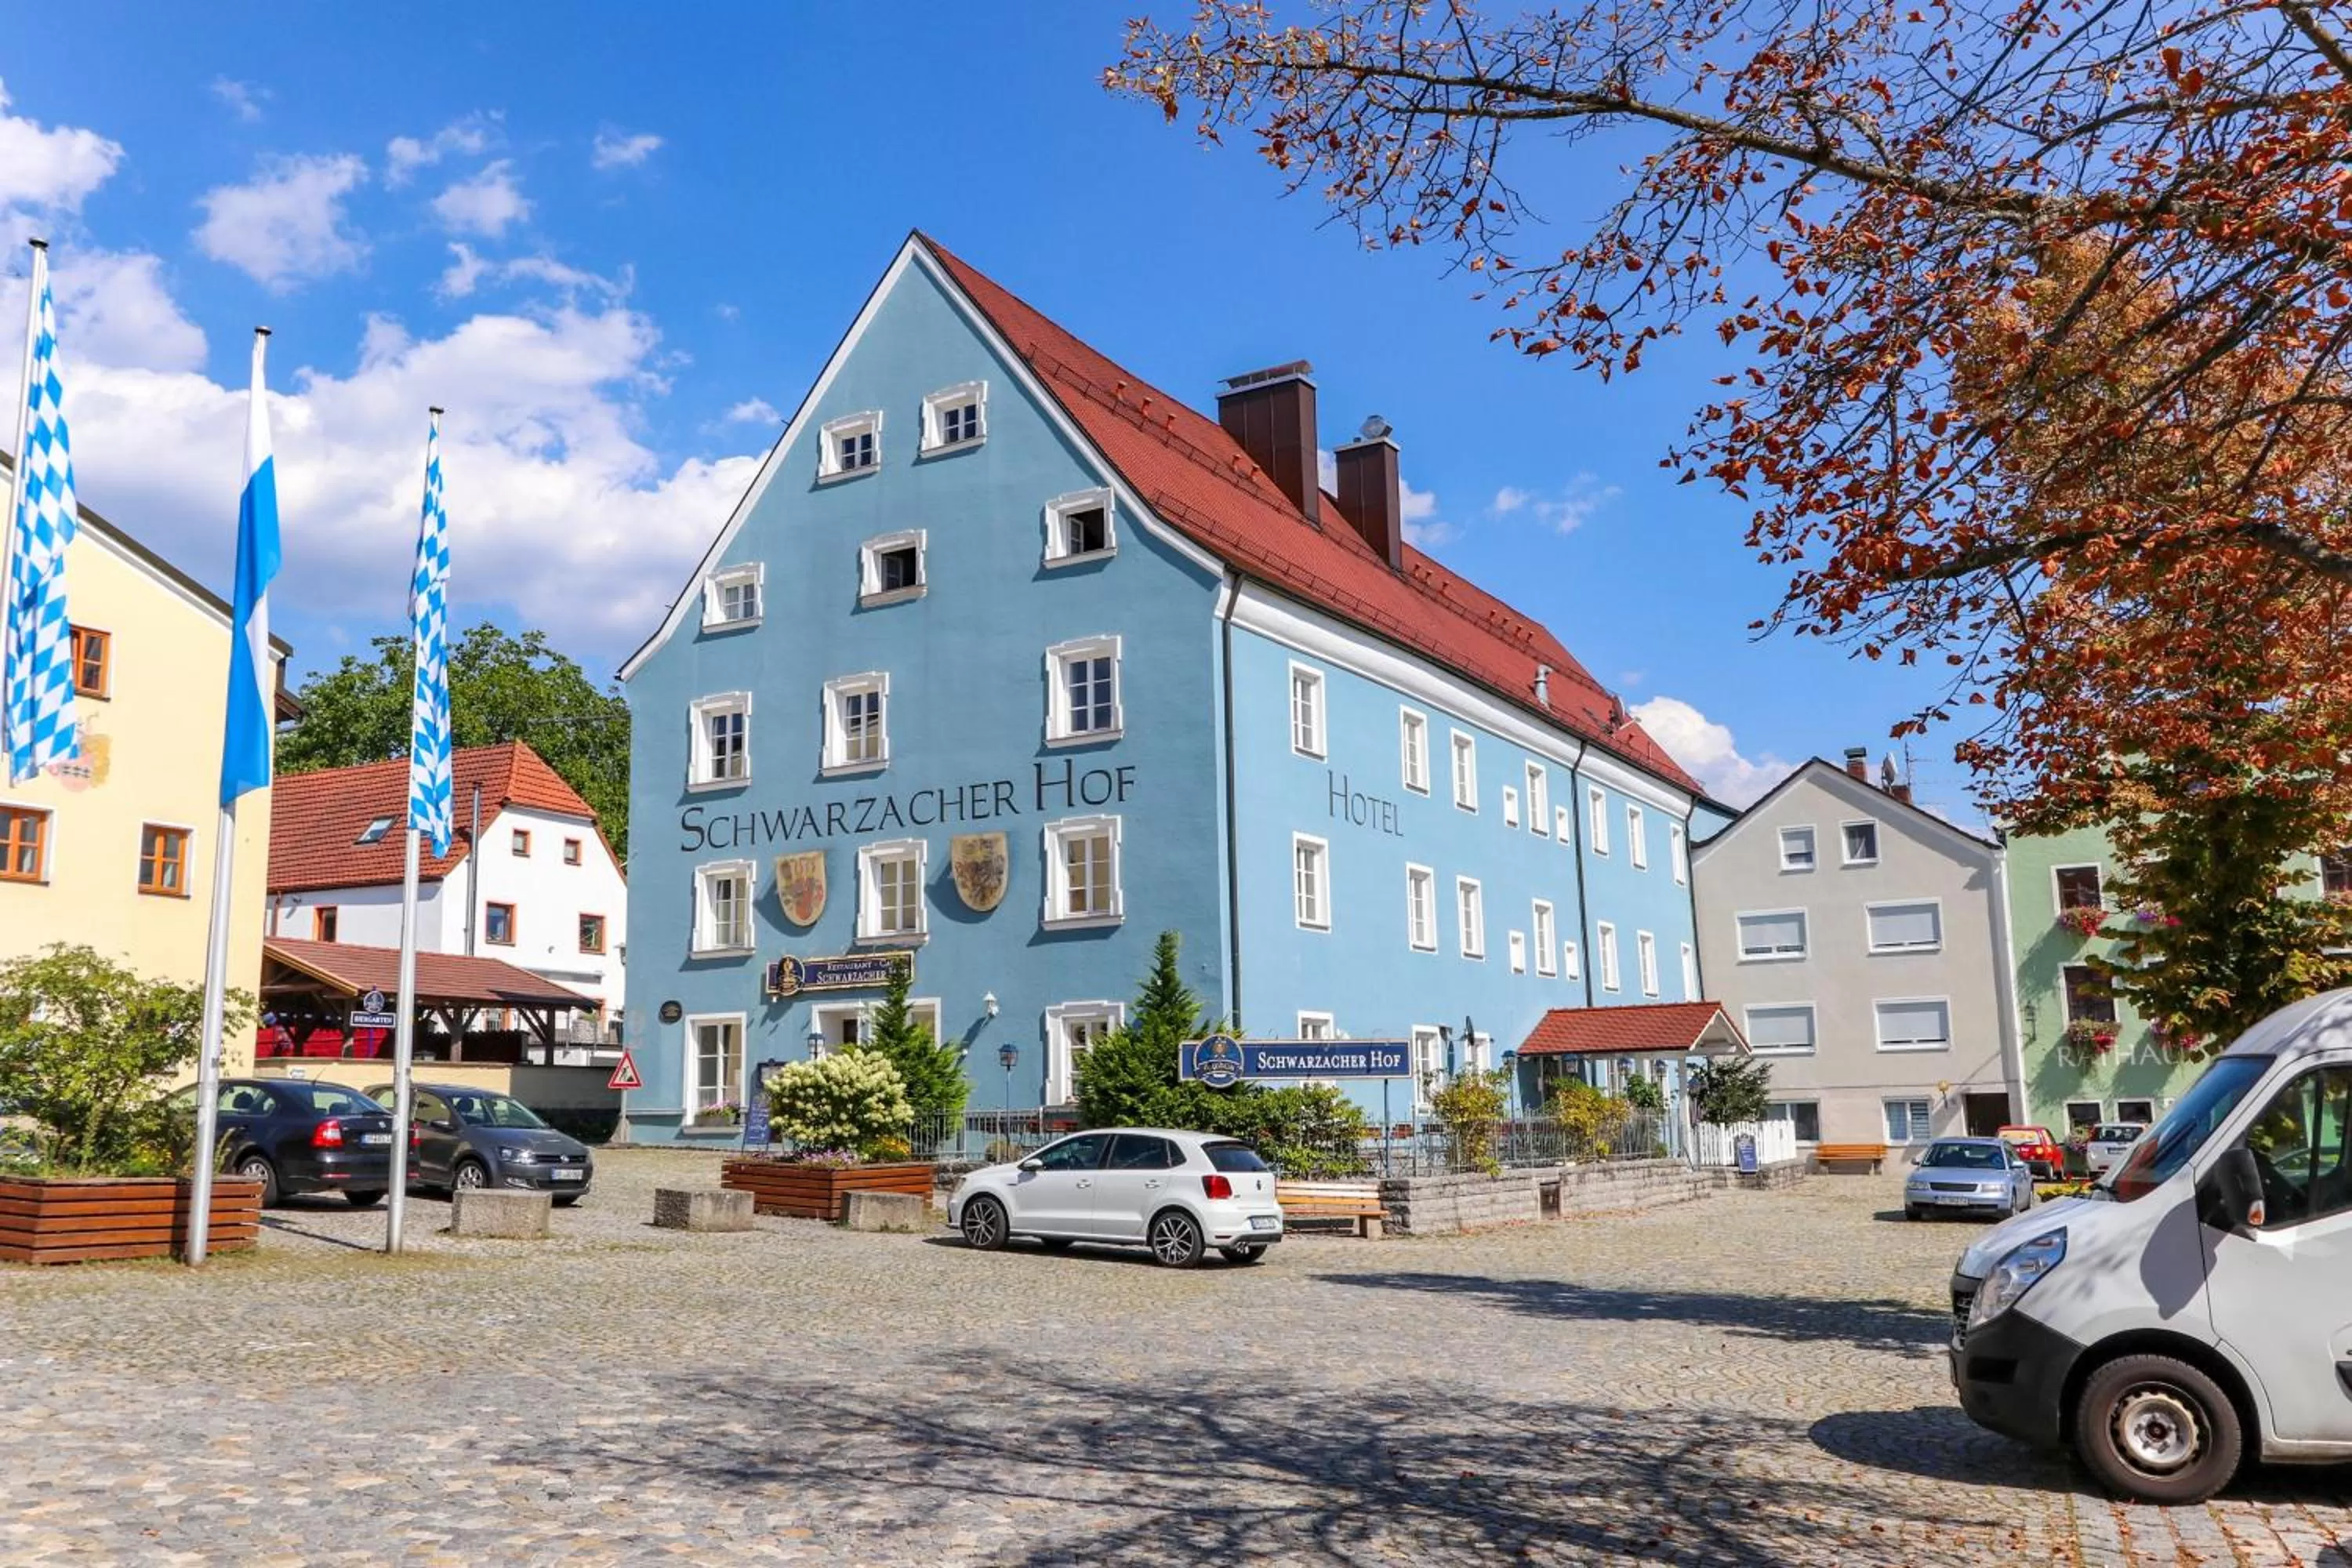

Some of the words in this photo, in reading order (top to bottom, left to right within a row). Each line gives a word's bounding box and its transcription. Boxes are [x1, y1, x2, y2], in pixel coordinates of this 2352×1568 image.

[681, 780, 1019, 852] SCHWARZACHER
[1033, 759, 1136, 811] HOF
[1328, 769, 1404, 837] HOTEL
[816, 970, 886, 985] SCHWARZACHER
[1258, 1051, 1367, 1069] SCHWARZACHER
[1370, 1051, 1401, 1067] HOF
